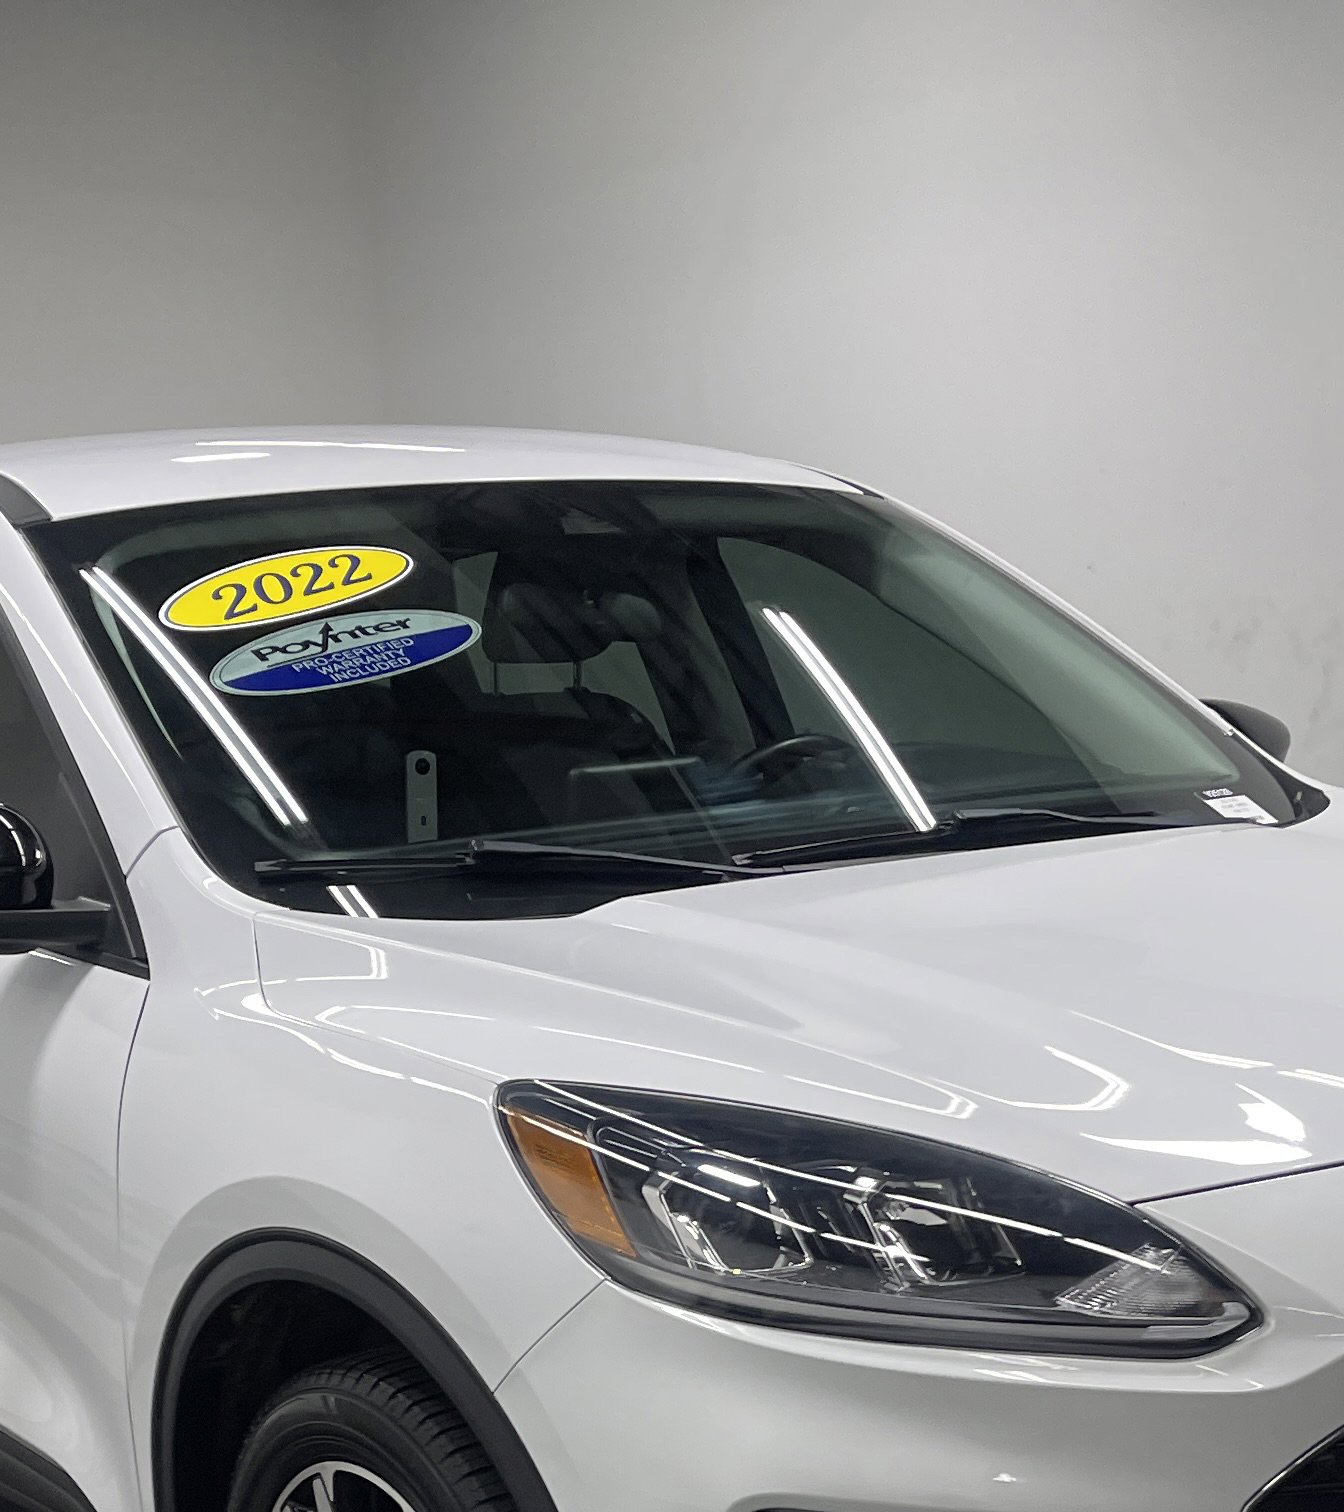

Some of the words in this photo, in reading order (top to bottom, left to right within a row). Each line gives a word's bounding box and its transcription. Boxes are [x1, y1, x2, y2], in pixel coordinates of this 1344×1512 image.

[212, 554, 373, 621] 2022
[251, 617, 411, 662] Poynter
[291, 637, 414, 673] PRO-CERTIFIED
[316, 648, 406, 676] WARRANTY
[329, 657, 412, 683] INCLUDED
